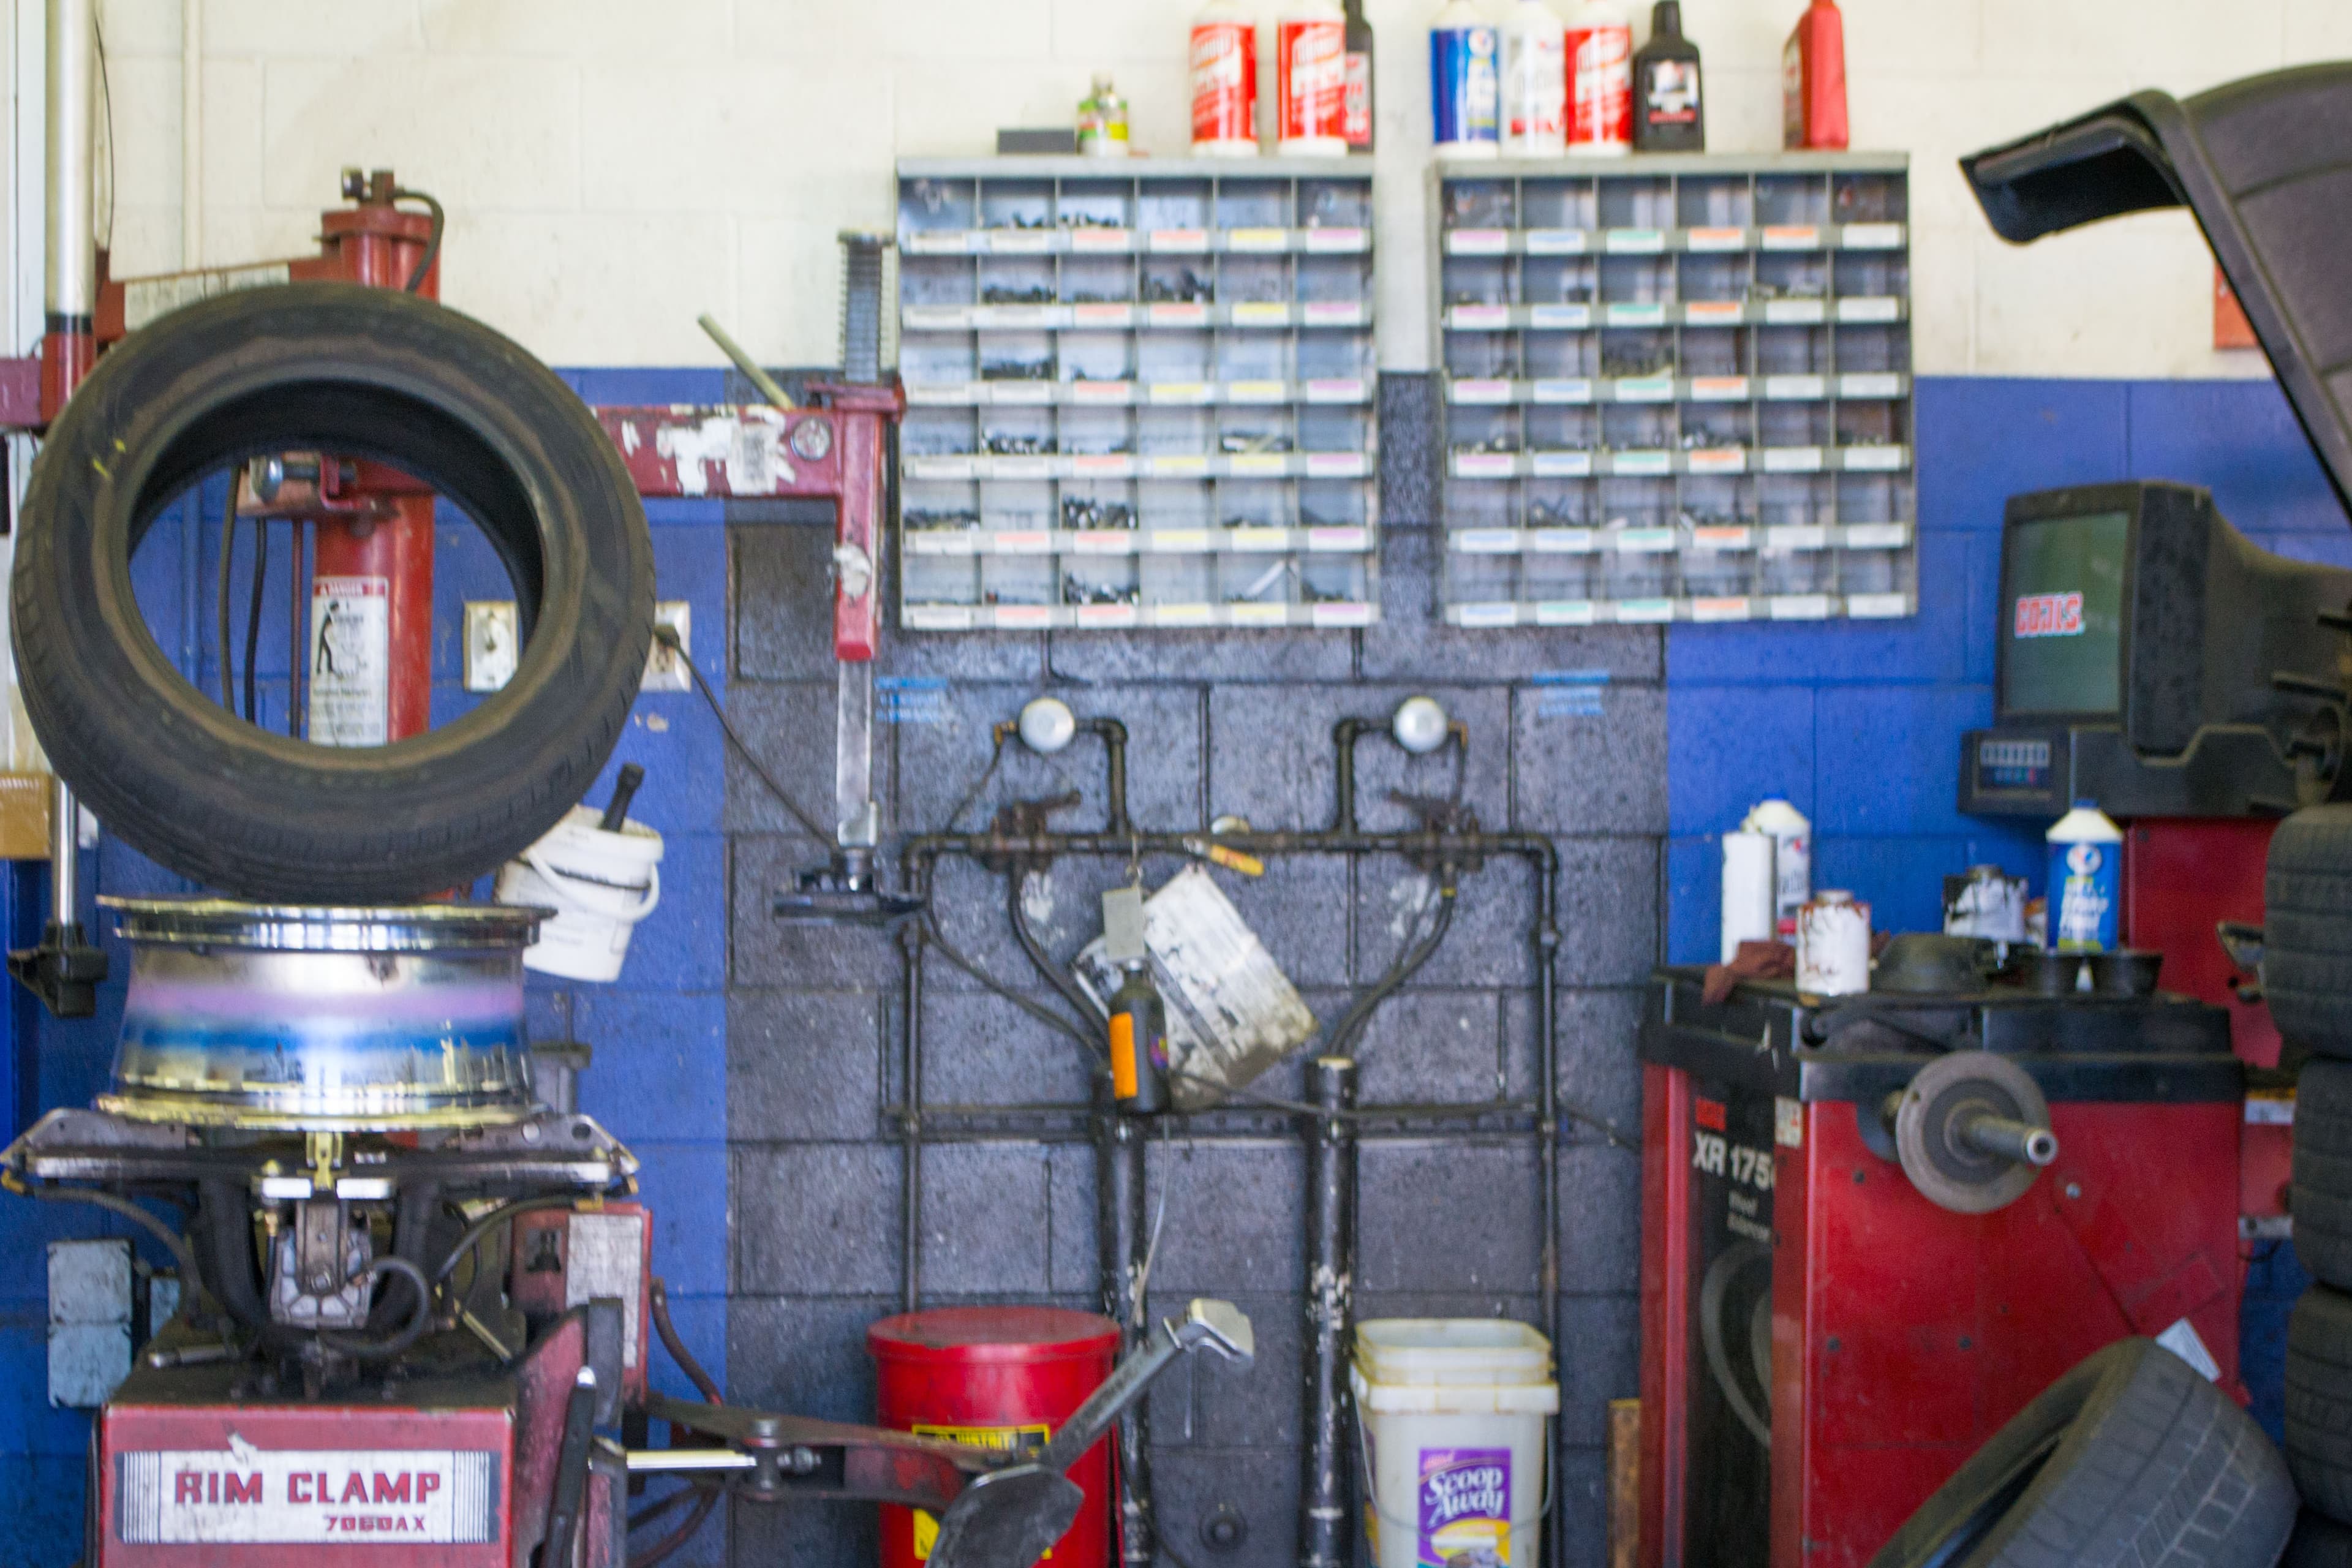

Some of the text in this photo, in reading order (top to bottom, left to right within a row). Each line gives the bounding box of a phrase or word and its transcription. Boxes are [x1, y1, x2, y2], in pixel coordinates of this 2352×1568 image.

[1730, 1144, 1775, 1191] 175
[175, 1472, 441, 1504] RIM CLAMP
[1425, 1468, 1504, 1504] Scoop
[1426, 1490, 1504, 1528] Away
